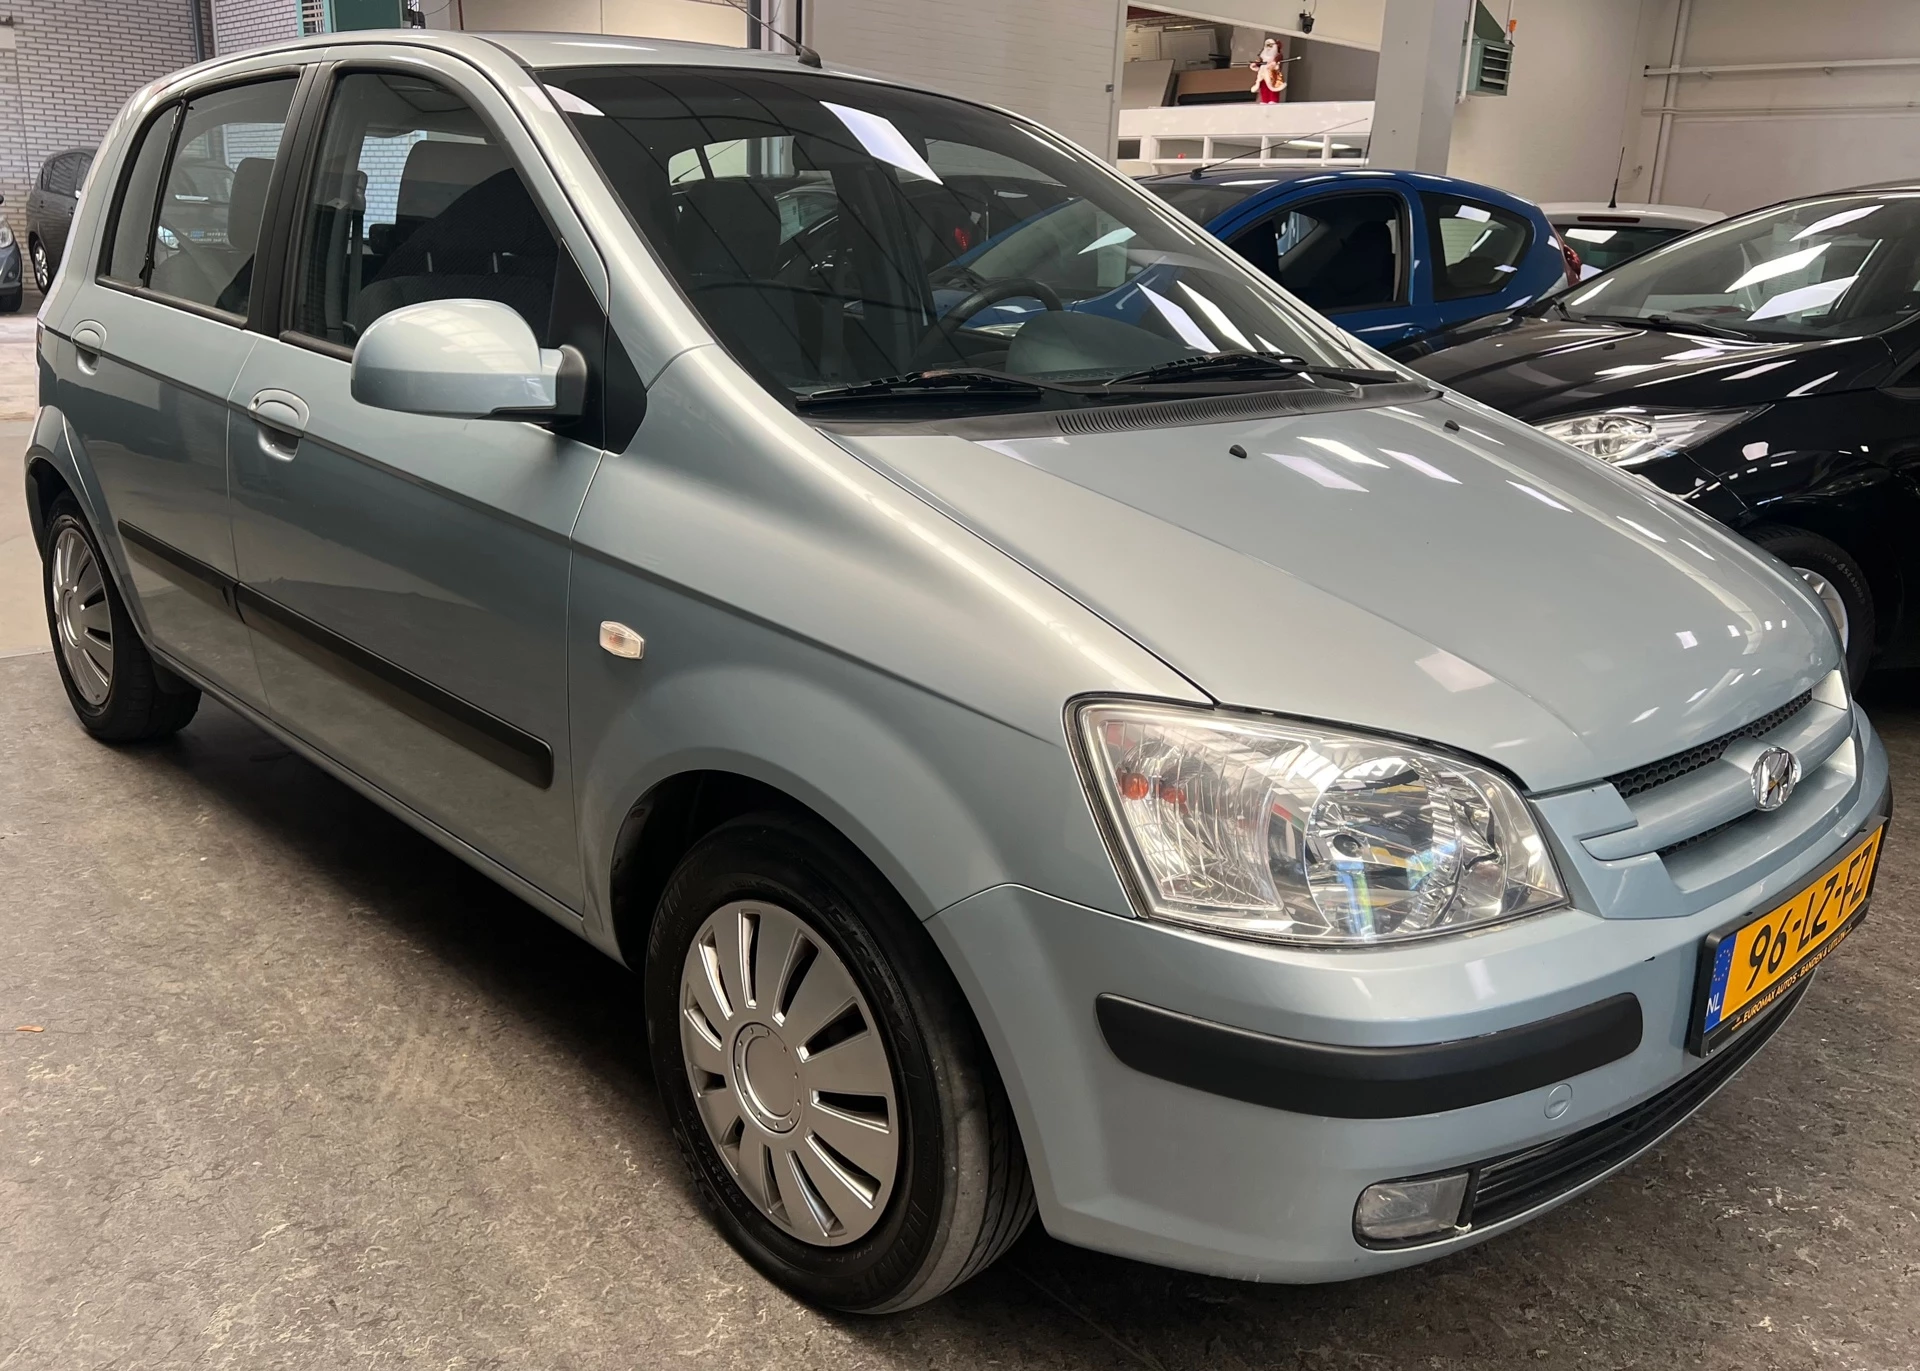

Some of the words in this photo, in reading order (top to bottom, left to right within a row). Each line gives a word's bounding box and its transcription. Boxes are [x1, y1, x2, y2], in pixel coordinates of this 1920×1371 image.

[1745, 841, 1874, 993] 96-LZ-FZ
[1706, 992, 1721, 1017] NL
[1743, 988, 1776, 1023] EUROMAX
